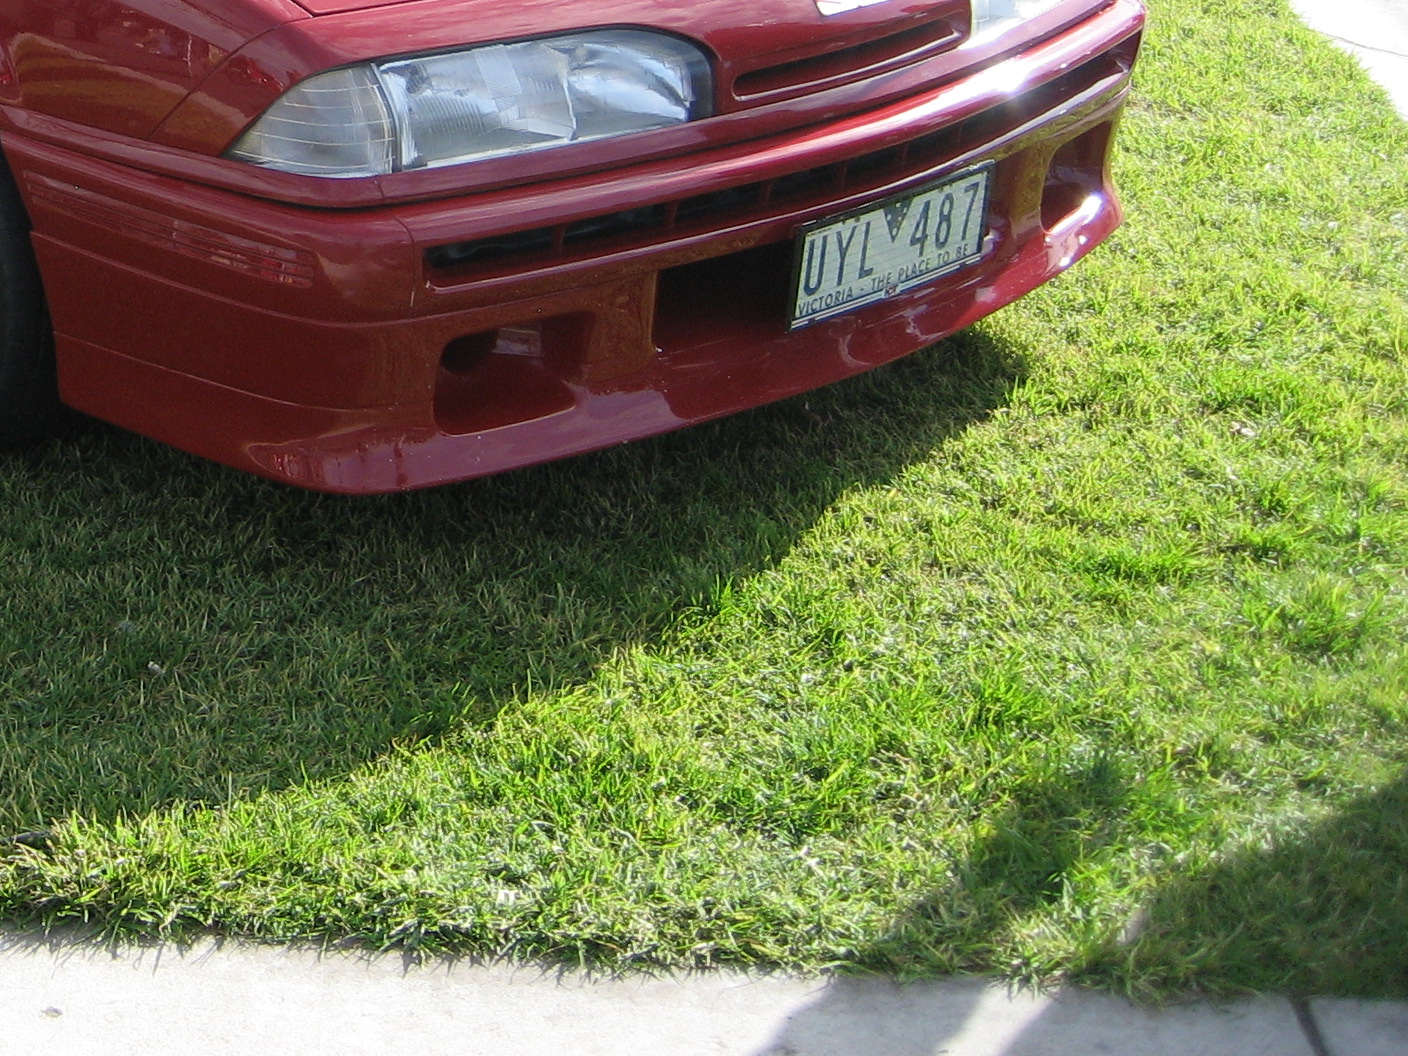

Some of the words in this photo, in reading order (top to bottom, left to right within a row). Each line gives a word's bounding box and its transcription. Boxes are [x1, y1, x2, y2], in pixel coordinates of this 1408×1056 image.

[797, 287, 853, 317] VICTORIA
[871, 271, 892, 291] THE
[898, 257, 931, 281] PLACE
[937, 250, 950, 264] TO
[955, 243, 969, 259] BE
[803, 220, 874, 296] UYL
[909, 182, 980, 258] 487
